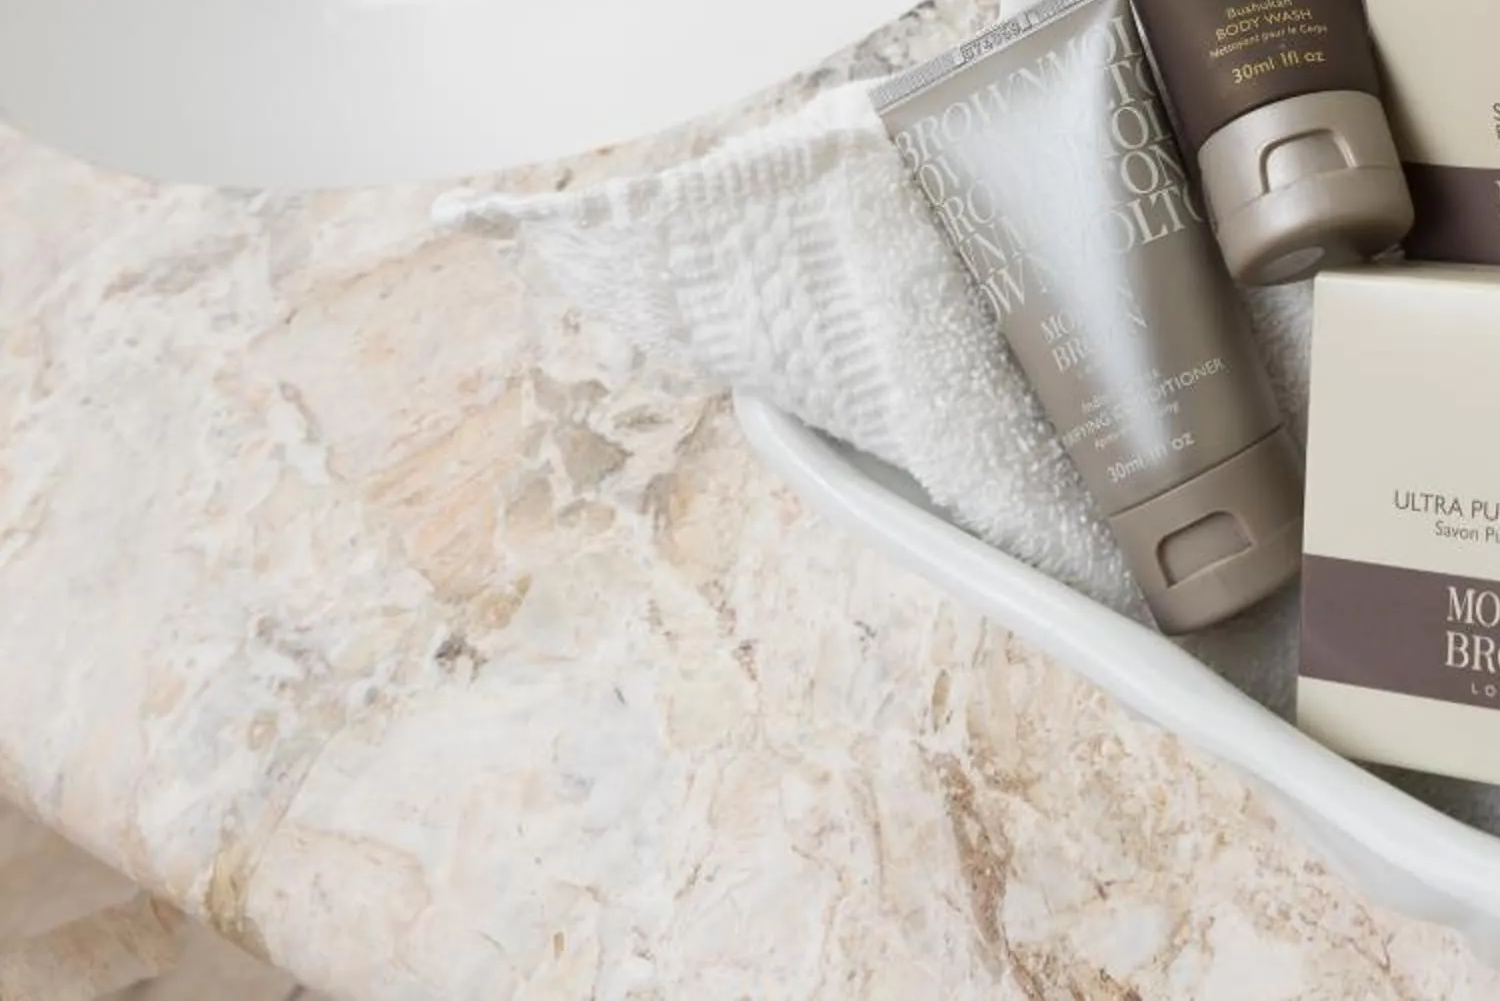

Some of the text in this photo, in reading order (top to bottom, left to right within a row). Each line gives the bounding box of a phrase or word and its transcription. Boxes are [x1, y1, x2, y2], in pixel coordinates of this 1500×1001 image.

[1215, 9, 1313, 41] BODY WASH
[1231, 56, 1276, 84] 30ml
[1303, 51, 1327, 62] oz
[1172, 432, 1195, 451] oz
[1393, 489, 1463, 517] ULTRA
[1434, 520, 1479, 542] Savon
